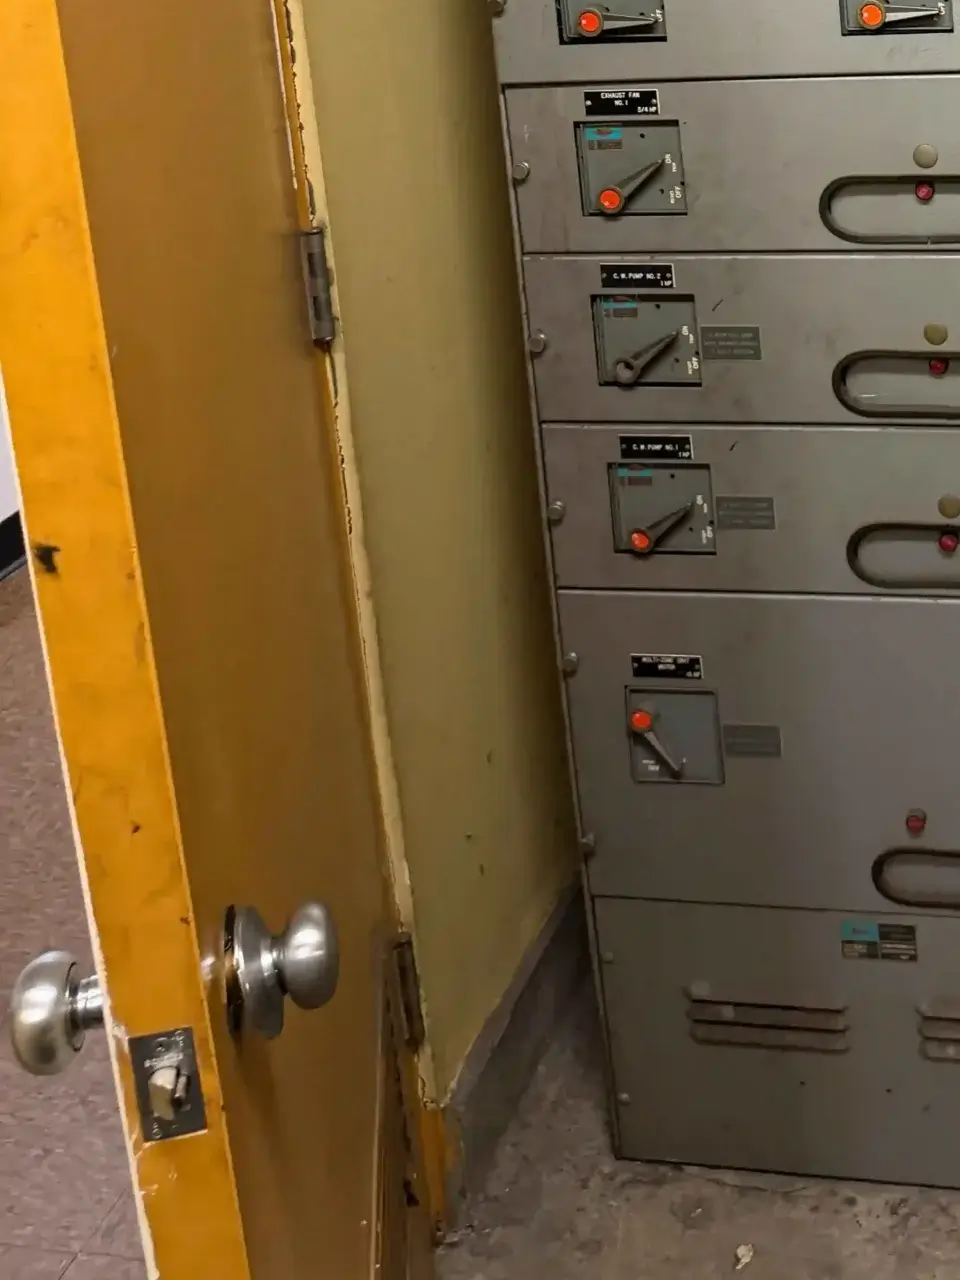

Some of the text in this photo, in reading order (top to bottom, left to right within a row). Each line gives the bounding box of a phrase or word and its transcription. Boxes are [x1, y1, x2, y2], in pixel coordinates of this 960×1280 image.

[664, 153, 672, 164] ON
[674, 185, 682, 198] OFF
[681, 325, 689, 336] ON
[691, 356, 699, 369] OFF
